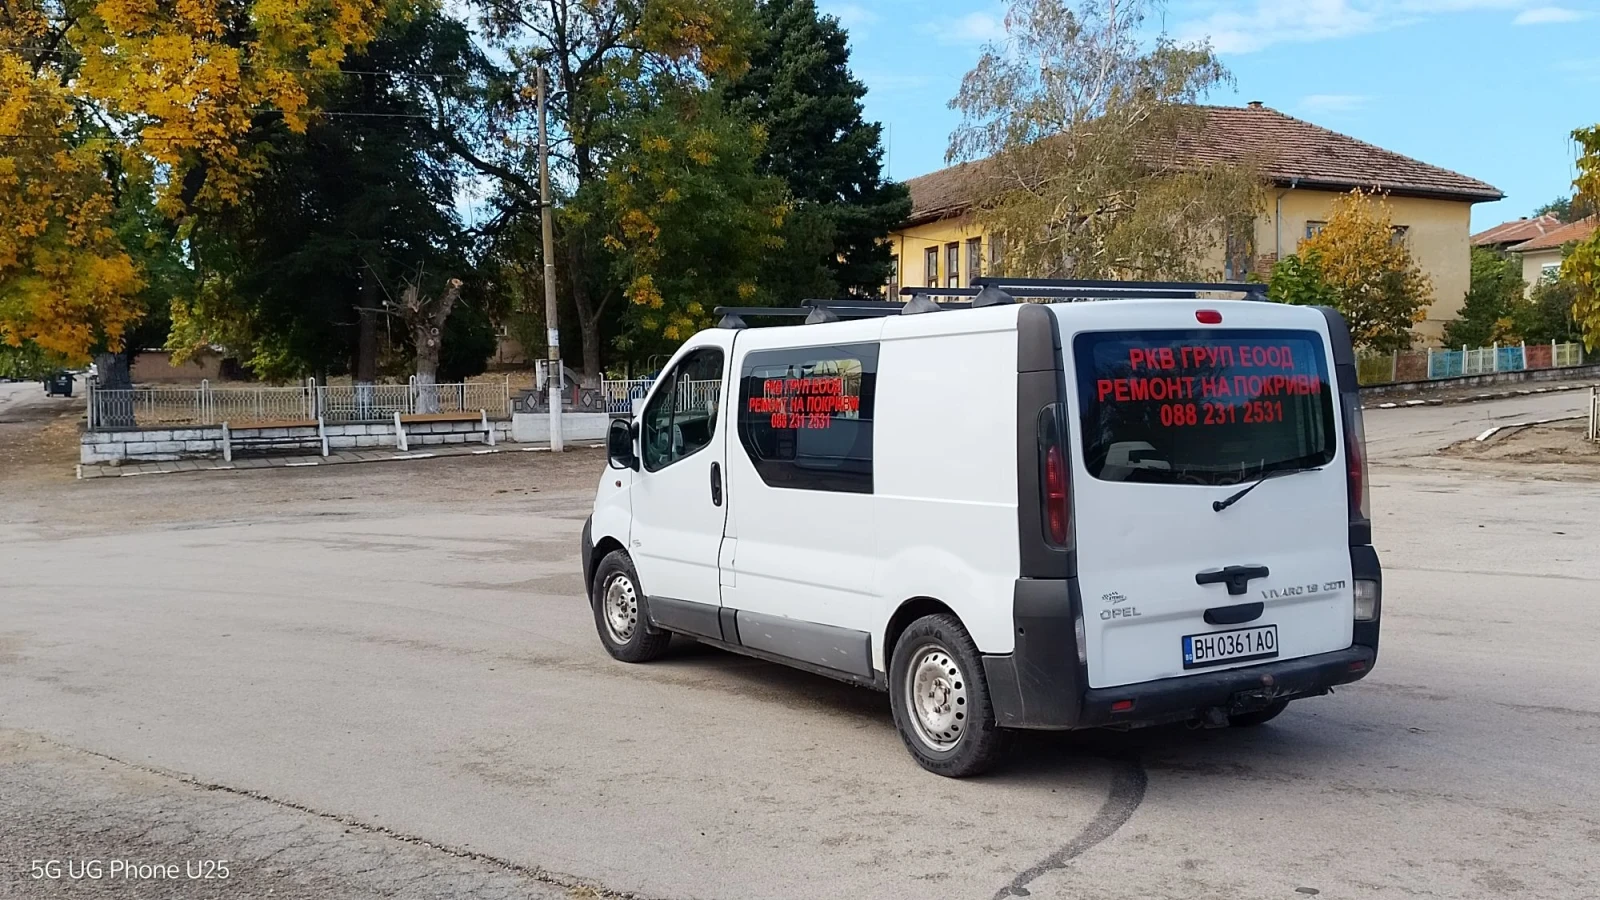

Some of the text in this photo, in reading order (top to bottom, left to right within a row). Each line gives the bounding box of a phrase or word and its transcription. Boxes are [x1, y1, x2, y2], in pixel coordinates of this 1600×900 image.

[1129, 346, 1293, 371] РКВ ГРУП ЕООД
[784, 378, 811, 395] ГРУП
[812, 377, 843, 395] ЕООД
[1097, 374, 1321, 402] РЕМОНТ НА ПОКРИВИ
[790, 397, 804, 412] НА
[1160, 400, 1283, 426] 088 231 2531
[771, 413, 831, 429] 088 231 2531
[1261, 586, 1303, 599] VIVARO
[1100, 607, 1142, 620] OPEL
